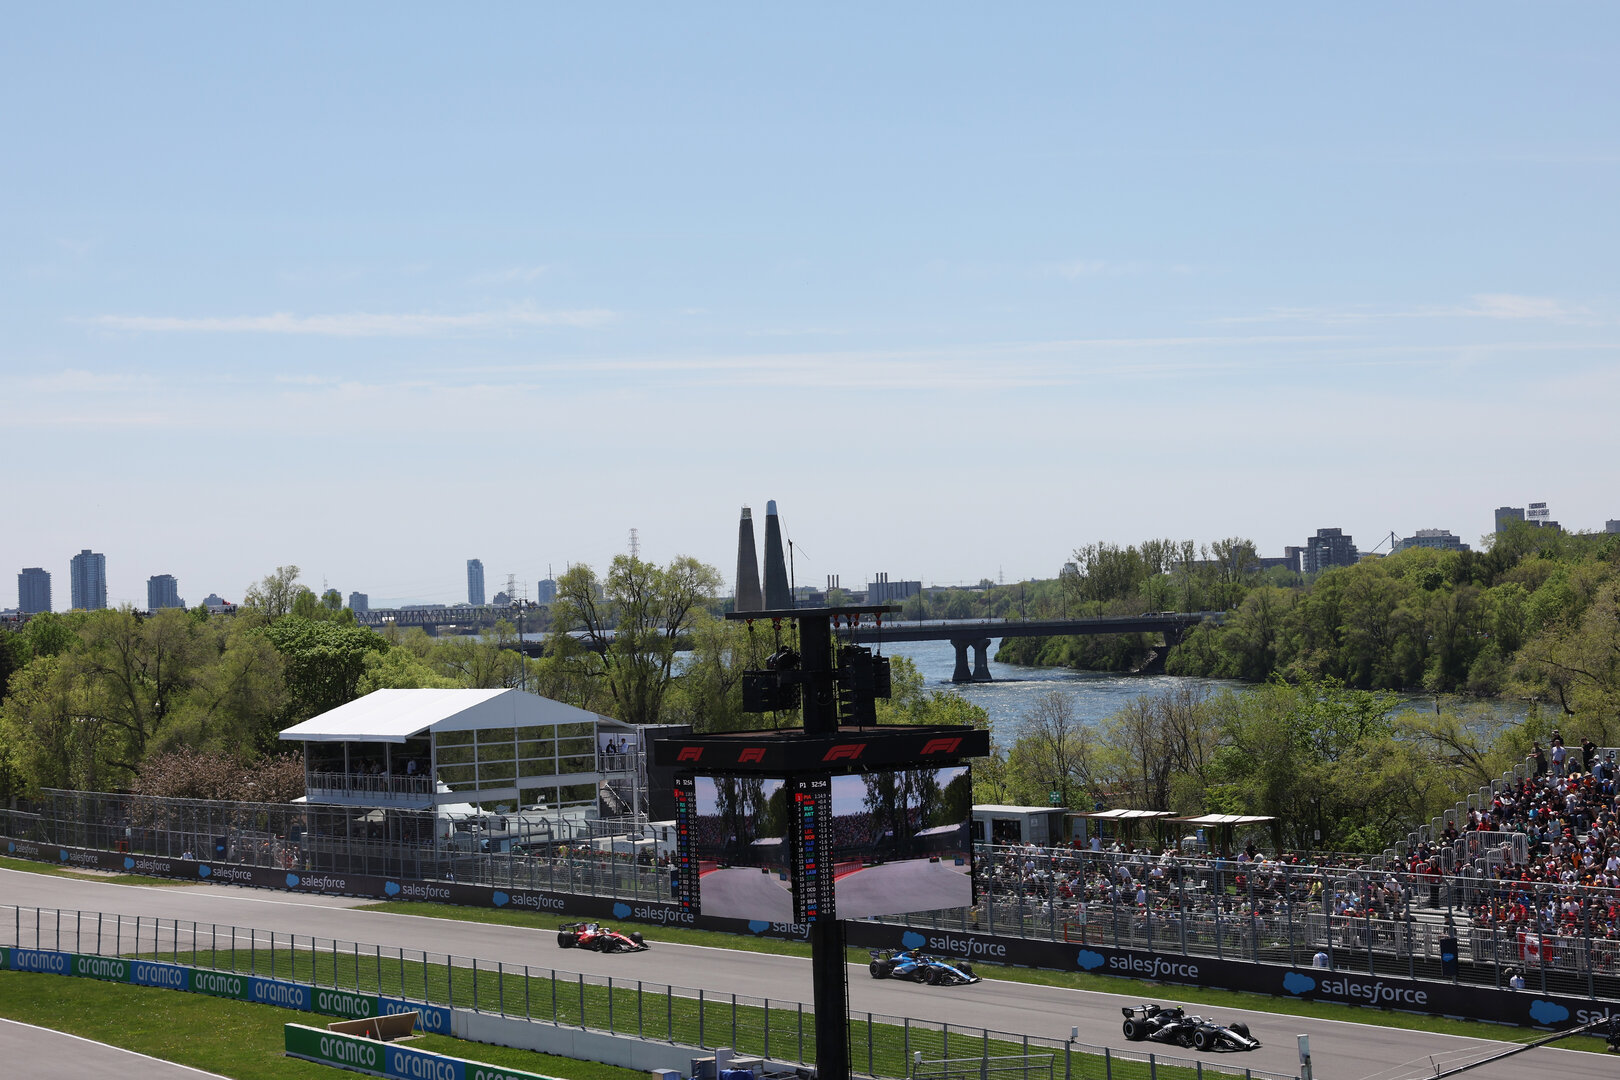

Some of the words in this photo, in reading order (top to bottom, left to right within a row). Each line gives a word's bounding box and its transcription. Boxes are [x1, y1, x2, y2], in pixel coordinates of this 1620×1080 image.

[16, 844, 38, 856] salesforce
[70, 851, 98, 864] salesforce
[136, 859, 170, 872] salesforce
[212, 867, 252, 881] salesforce
[301, 875, 345, 890] salesforce
[402, 883, 450, 899] salesforce
[512, 893, 565, 910] salesforce
[634, 905, 694, 923] salesforce
[773, 922, 812, 938] salesf
[930, 936, 1006, 956] salesforce
[17, 951, 64, 971] aramco
[78, 958, 124, 978] aramco
[1110, 955, 1198, 977] salesforce
[137, 964, 182, 986] aramco
[196, 973, 241, 994] aramco
[256, 982, 303, 1005] aramco
[1321, 979, 1428, 1004] salesforce
[319, 992, 370, 1016] aramco
[320, 1036, 376, 1066] aramco
[394, 1052, 455, 1080] aramco
